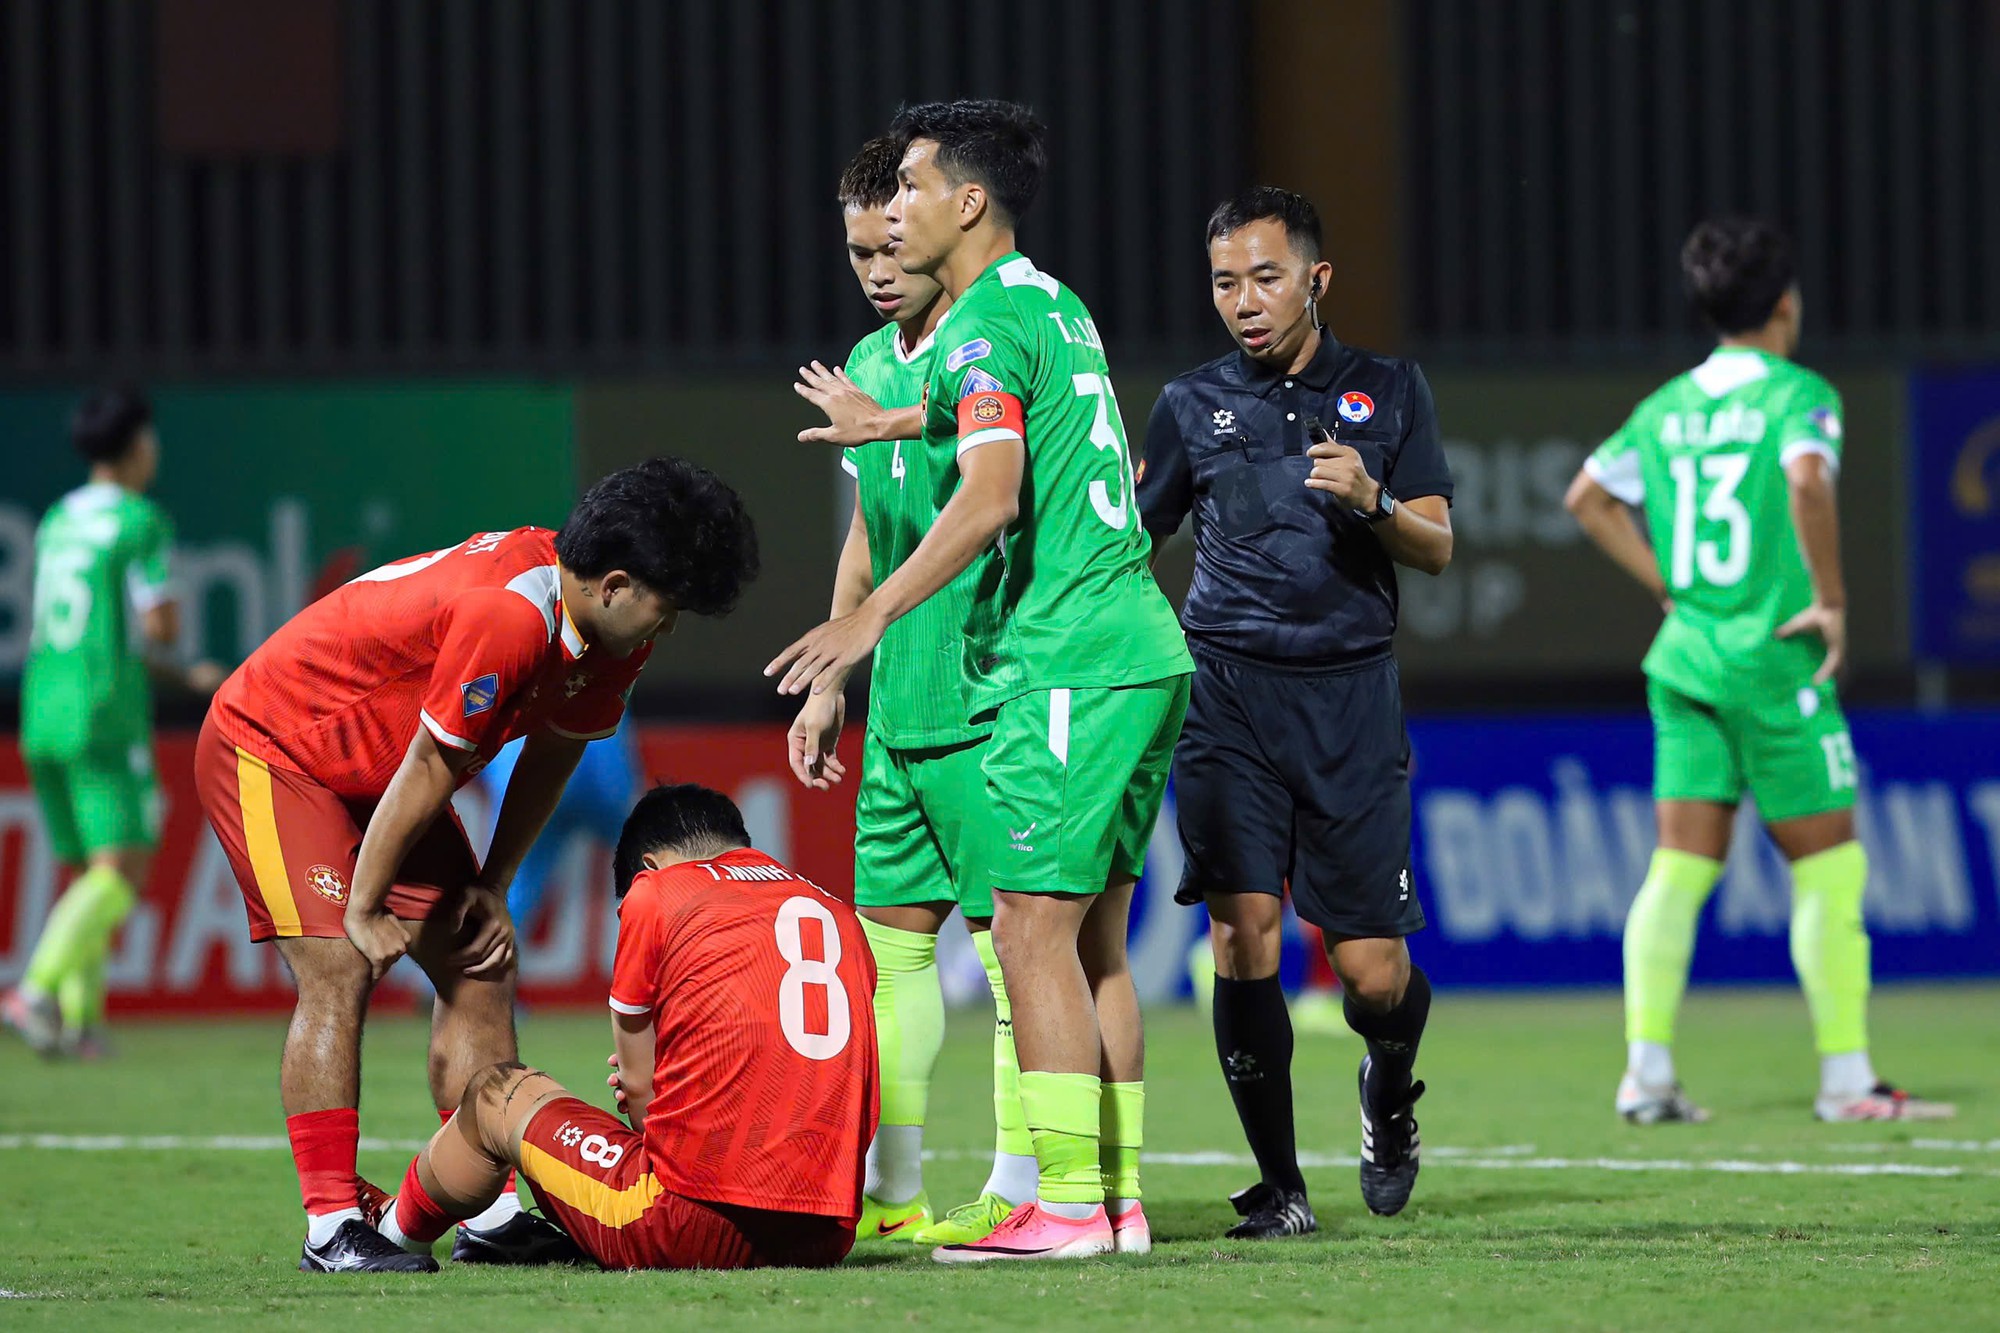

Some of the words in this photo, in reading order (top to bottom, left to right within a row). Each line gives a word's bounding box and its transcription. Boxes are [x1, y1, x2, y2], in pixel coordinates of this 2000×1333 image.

[891, 439, 906, 490] 4
[1669, 453, 1750, 589] 13
[773, 895, 851, 1061] 8
[580, 1134, 624, 1169] 8
